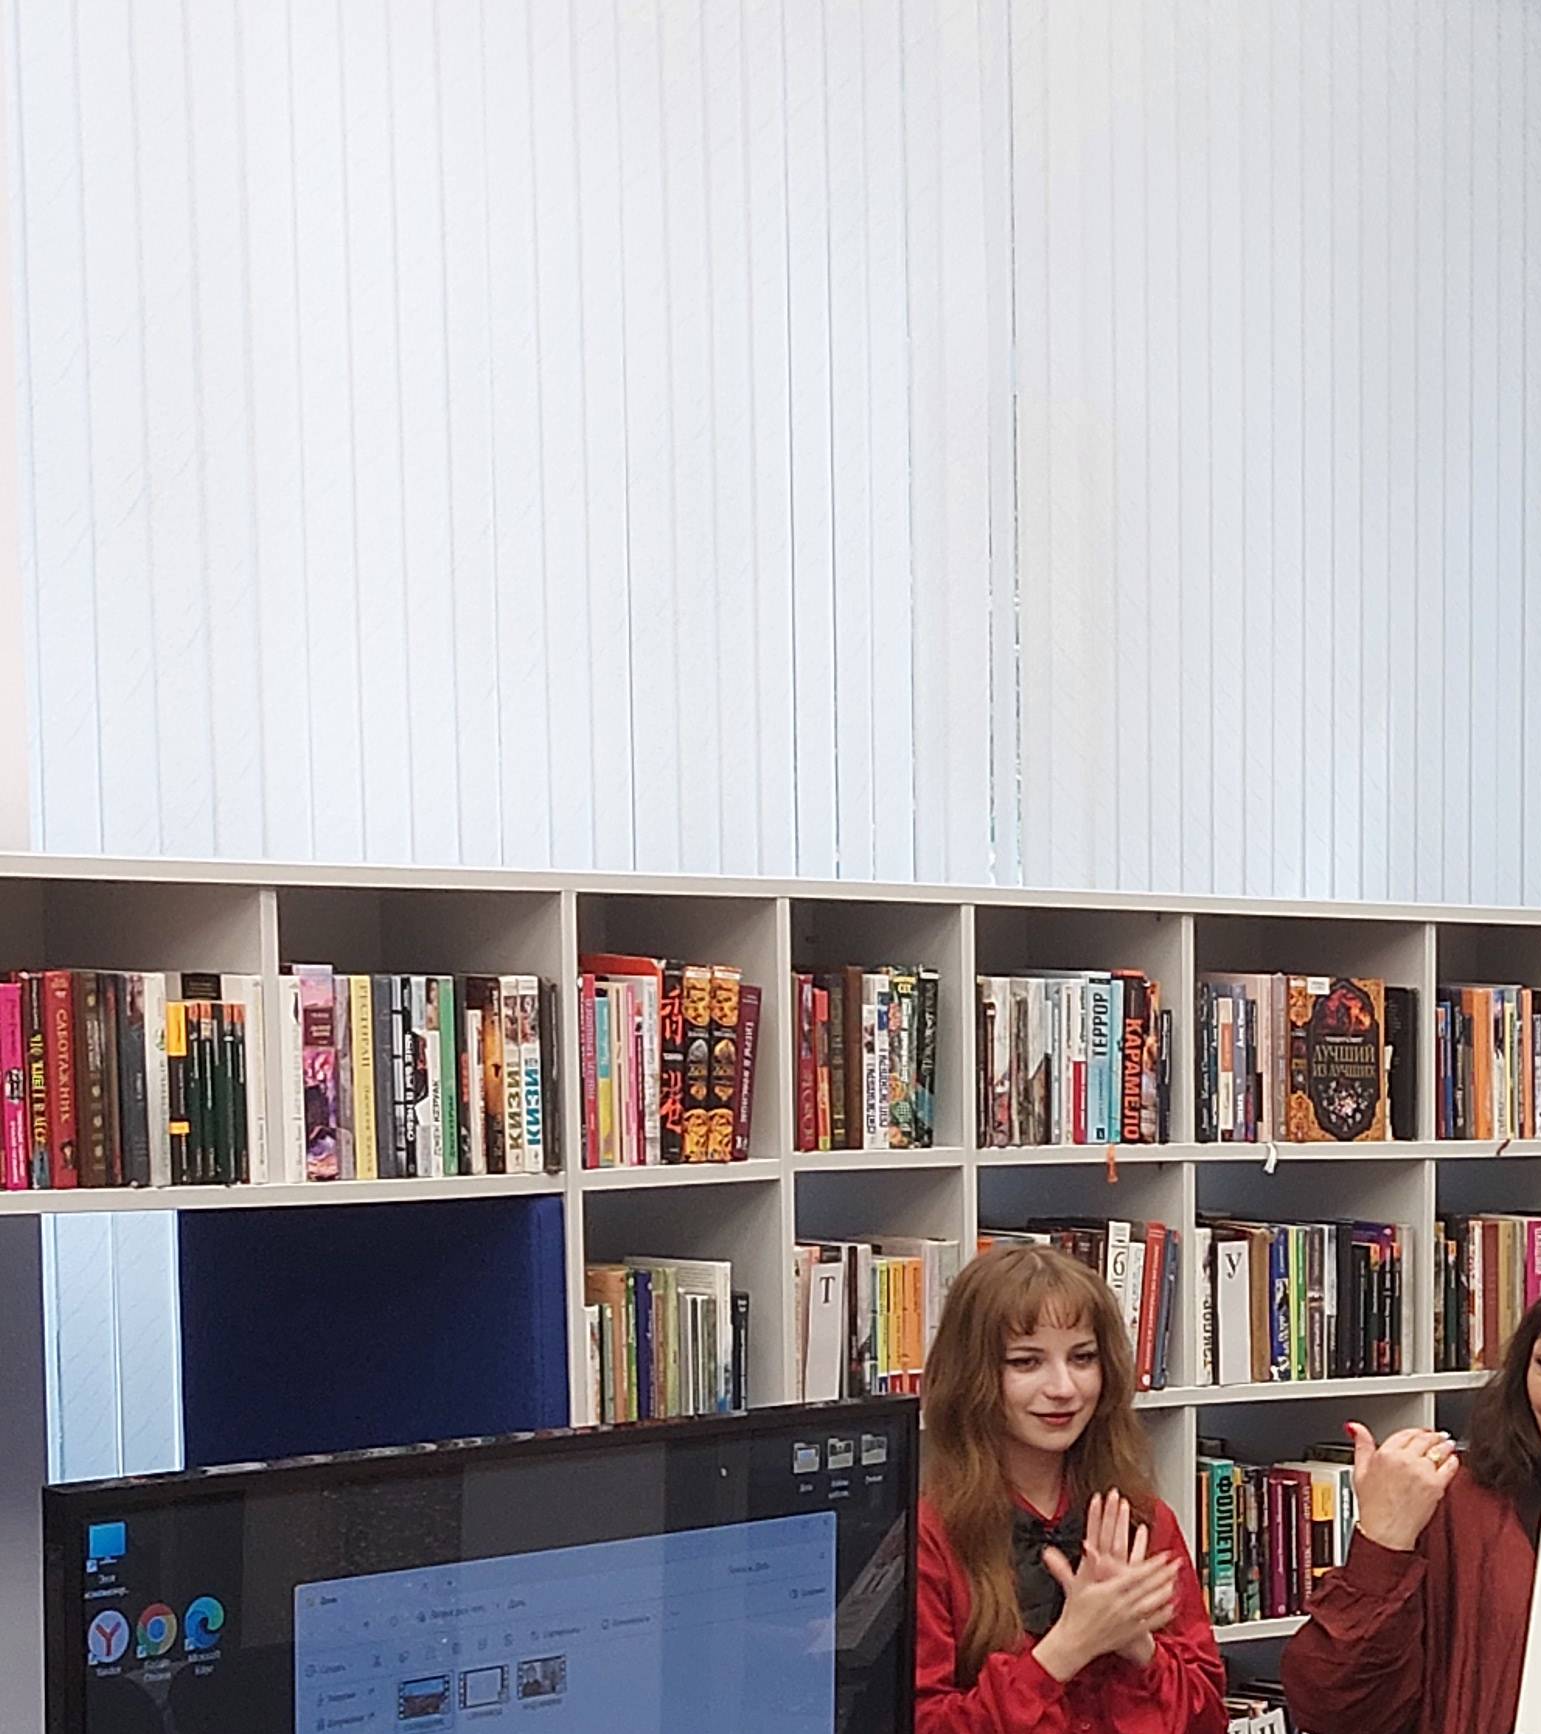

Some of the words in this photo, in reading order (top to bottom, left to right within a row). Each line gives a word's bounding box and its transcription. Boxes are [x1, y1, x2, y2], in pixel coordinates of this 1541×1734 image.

[1092, 992, 1108, 1058] ТЕРРОР
[1313, 1044, 1376, 1062] ЛУЧШИЙ
[55, 1008, 72, 1124] САБОТАЖНИК
[1123, 1018, 1143, 1140] КАРАМЕЛО
[1313, 1064, 1328, 1077] ИЗ
[1330, 1064, 1376, 1078] ЛУЧШИХ
[507, 1068, 522, 1151] КИЗИ
[525, 1066, 541, 1146] КИЗИ
[820, 1276, 835, 1304] Т
[1225, 1252, 1242, 1279] У
[1216, 1476, 1234, 1567] ФОЛЛЕТТ
